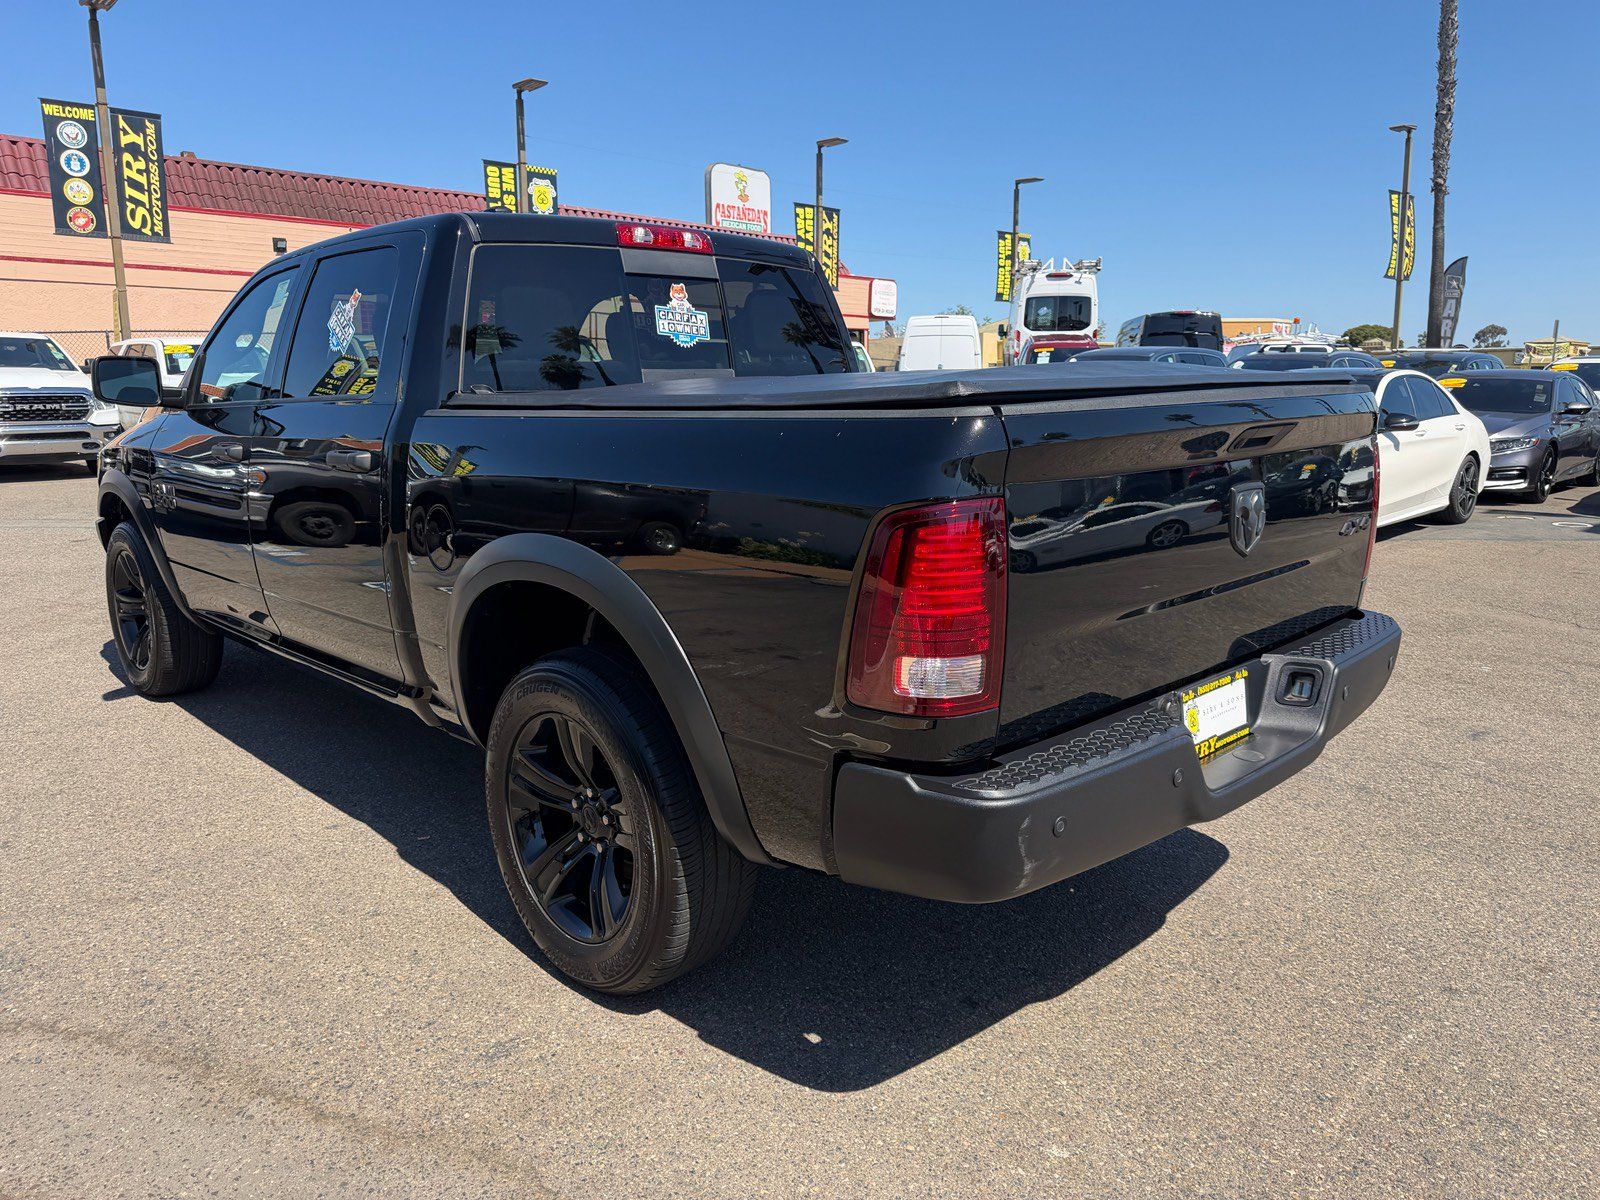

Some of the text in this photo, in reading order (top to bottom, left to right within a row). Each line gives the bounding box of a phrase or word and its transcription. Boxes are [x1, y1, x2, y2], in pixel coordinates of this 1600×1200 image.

[42, 103, 96, 121] WELCOME
[118, 114, 152, 236] SIRY
[145, 119, 164, 237] MOTORS.COM
[486, 165, 501, 199] OUR
[501, 167, 515, 192] WE
[1391, 194, 1399, 214] WE
[747, 223, 762, 232] FOOD
[795, 207, 806, 239] PAY
[805, 207, 814, 243] BUY
[997, 239, 1006, 294] AUTO CARE
[1387, 242, 1398, 277] CARS
[659, 309, 706, 325] CARFAX
[516, 683, 560, 700] CRUGEN
